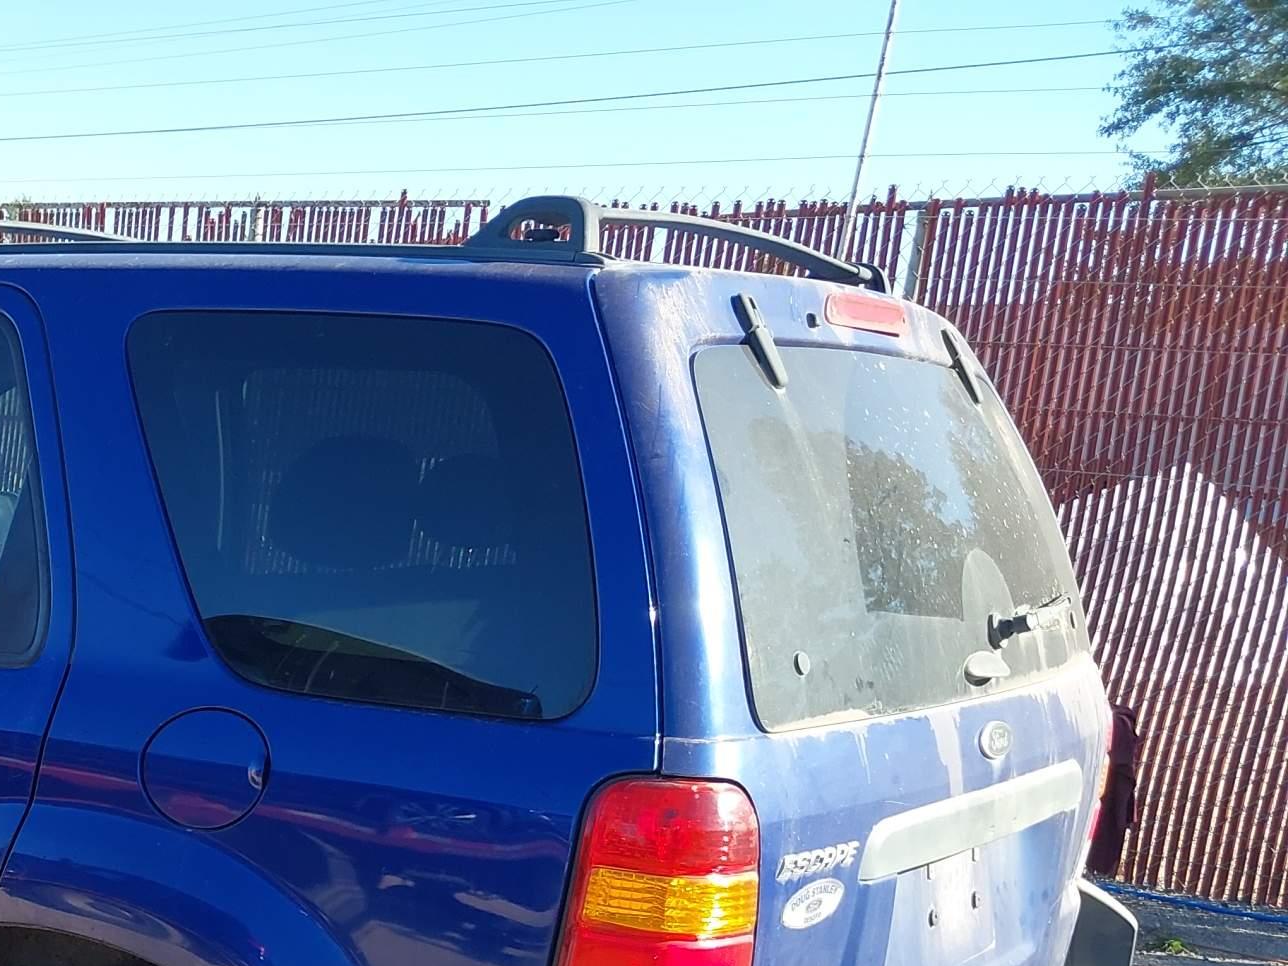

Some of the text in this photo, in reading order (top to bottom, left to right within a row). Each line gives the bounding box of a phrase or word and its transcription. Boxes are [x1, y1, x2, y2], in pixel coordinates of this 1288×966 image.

[776, 841, 860, 881] ESCAPE
[791, 888, 810, 911] DOUG
[812, 884, 839, 898] STANLEY
